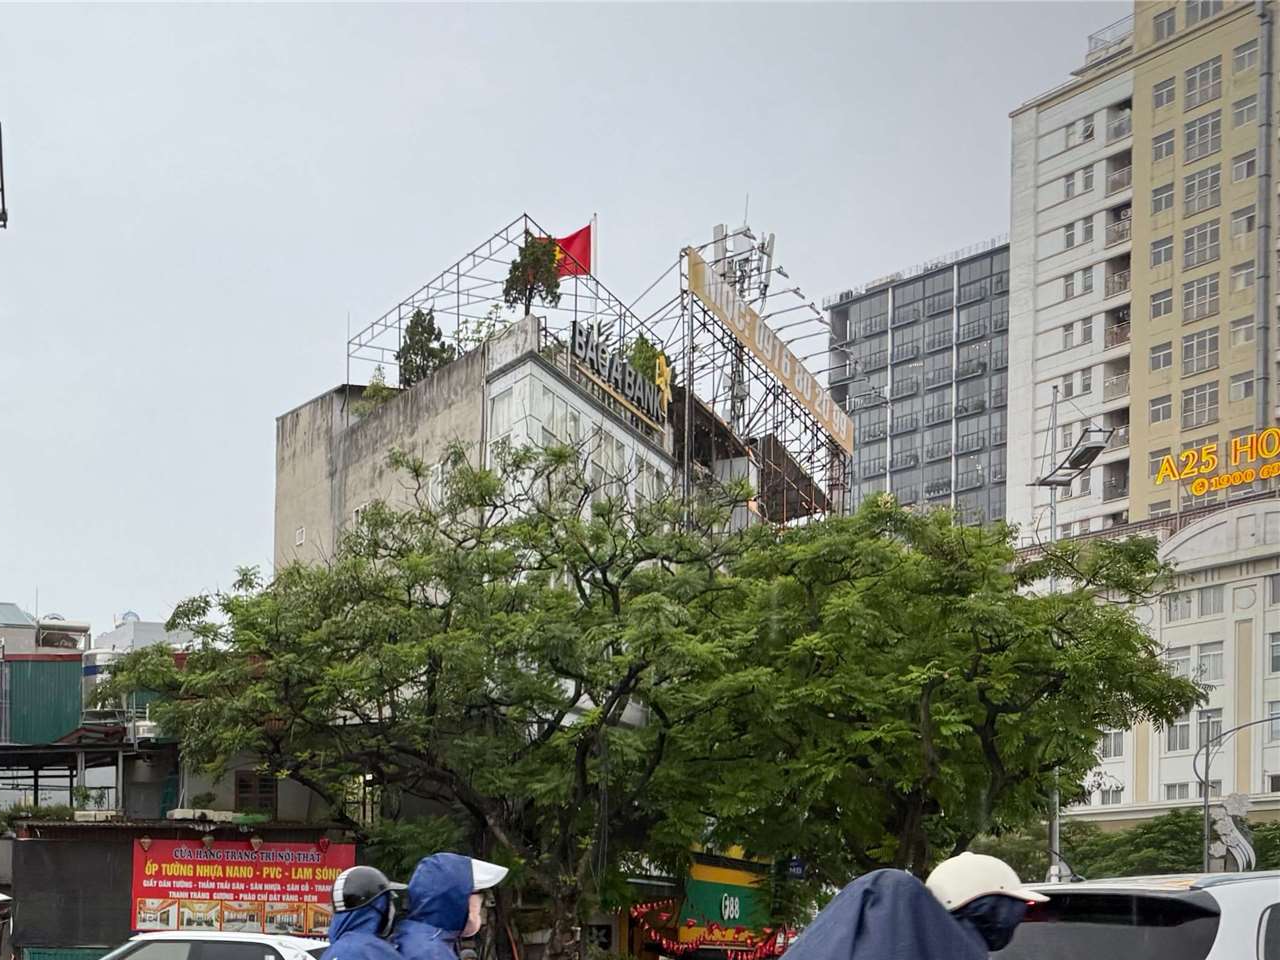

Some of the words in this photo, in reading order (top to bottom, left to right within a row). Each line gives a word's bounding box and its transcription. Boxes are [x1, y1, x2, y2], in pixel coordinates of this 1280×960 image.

[756, 314, 790, 379] 0916
[795, 358, 811, 400] 80
[1156, 443, 1218, 485] A25
[1231, 427, 1280, 466] HO
[1210, 468, 1256, 491] 1900
[145, 859, 159, 876] ỐP
[161, 861, 193, 877] TƯỜNG
[196, 863, 224, 880] NHỰA
[226, 865, 254, 879] NANO
[263, 866, 282, 880] PVC
[291, 867, 313, 880] LAM
